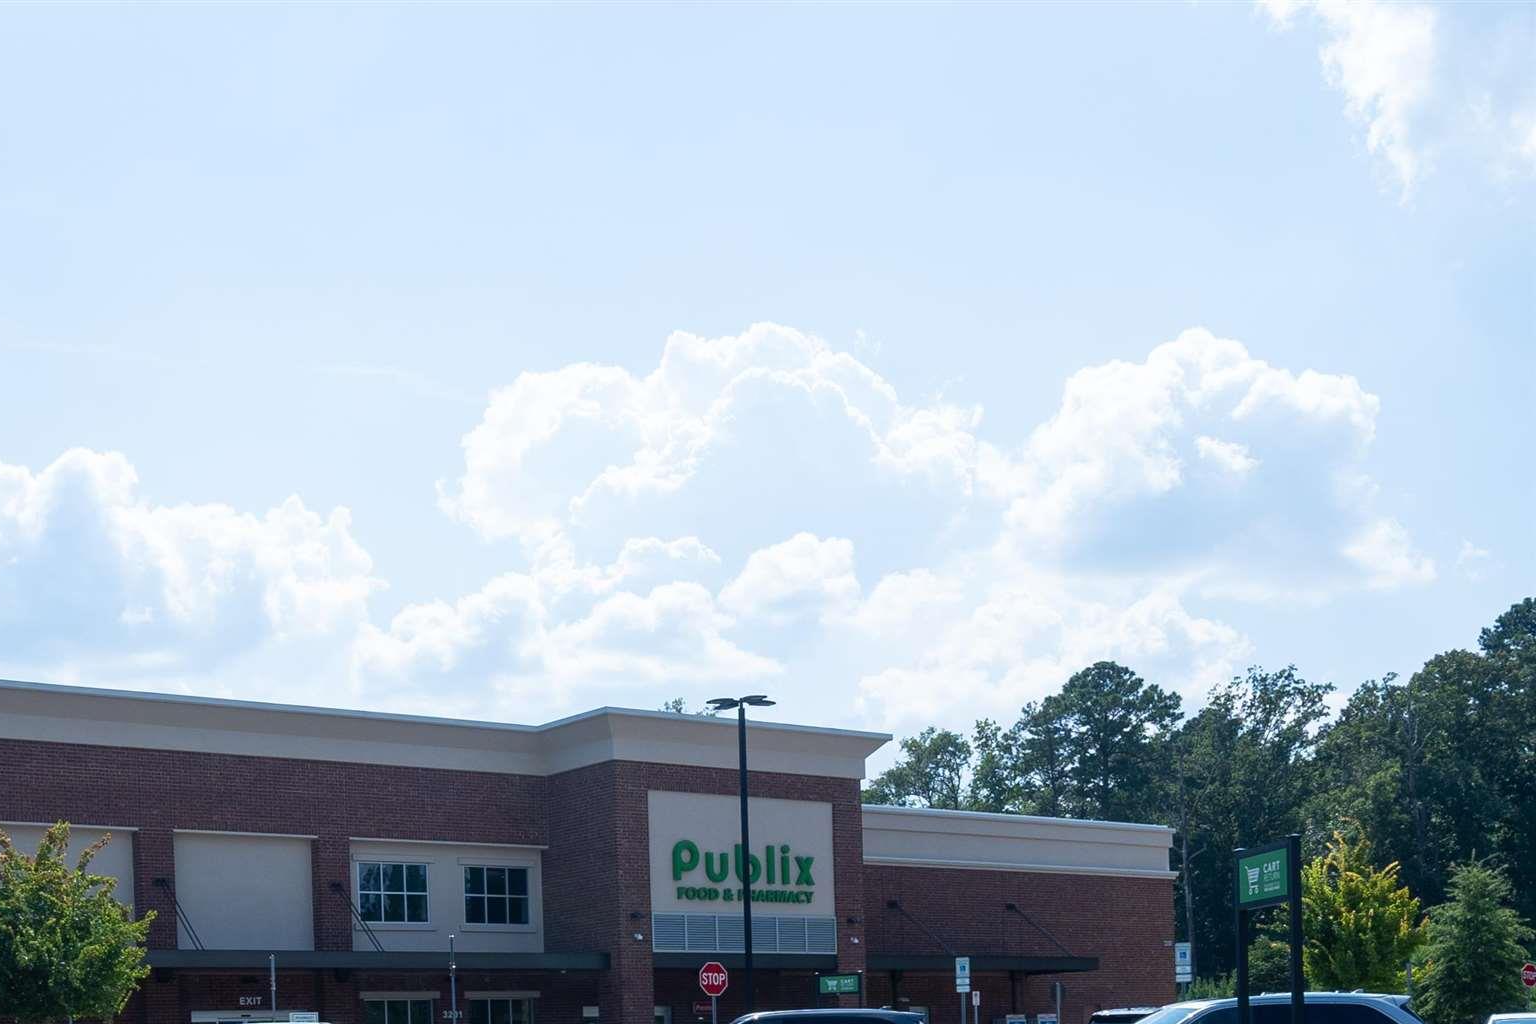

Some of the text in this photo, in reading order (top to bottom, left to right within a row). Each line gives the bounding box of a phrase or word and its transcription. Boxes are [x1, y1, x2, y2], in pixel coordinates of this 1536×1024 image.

[672, 840, 815, 885] Publix
[1263, 860, 1281, 873] CART
[677, 886, 719, 900] FOOD
[723, 887, 734, 902] &
[702, 972, 726, 985] STOP
[239, 996, 262, 1006] EXIT
